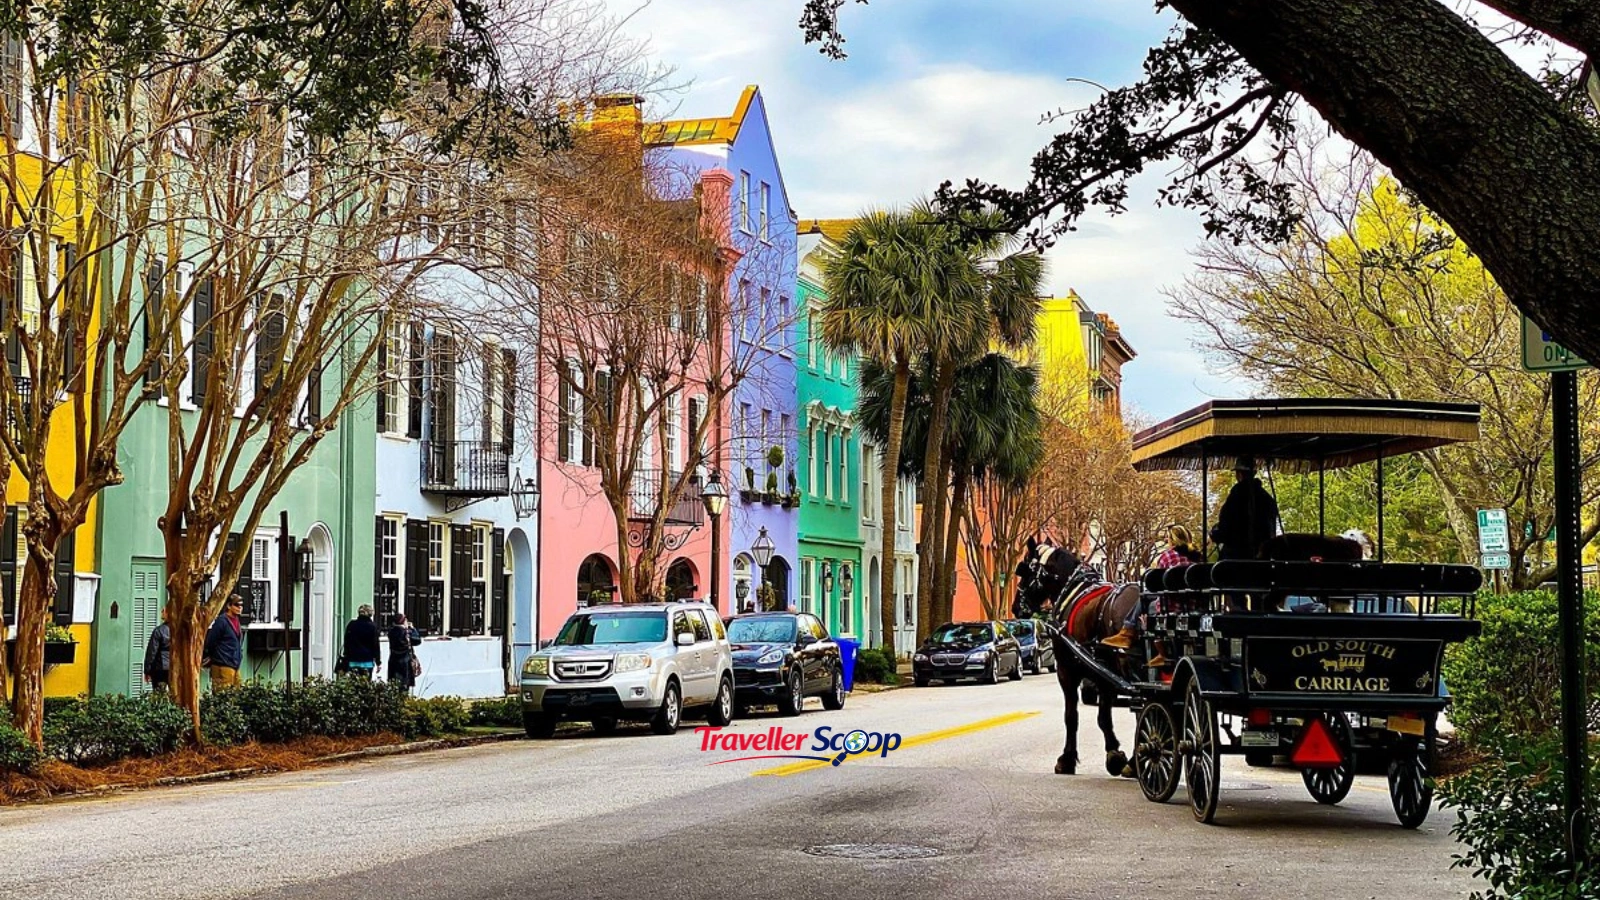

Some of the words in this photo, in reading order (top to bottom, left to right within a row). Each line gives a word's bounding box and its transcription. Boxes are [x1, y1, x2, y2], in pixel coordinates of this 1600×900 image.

[1544, 345, 1575, 363] ONL
[1291, 641, 1329, 657] OLD
[1334, 640, 1396, 659] SOUTH
[1294, 676, 1391, 691] CARRIAGE
